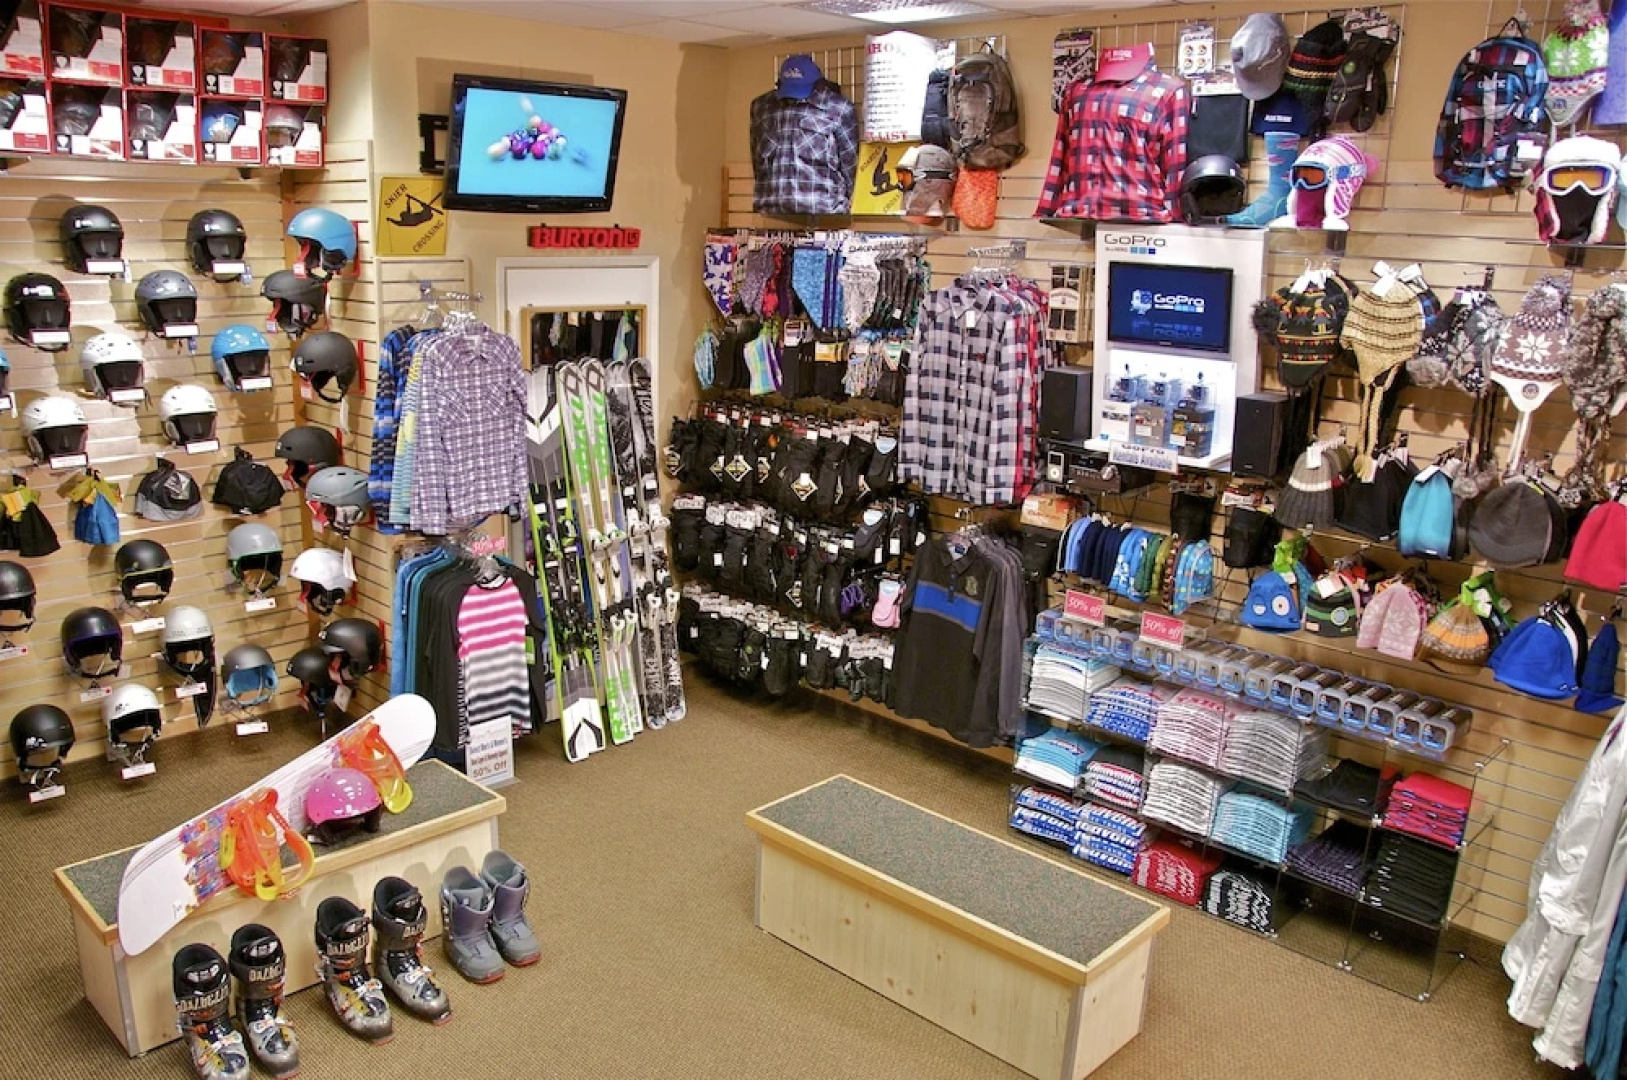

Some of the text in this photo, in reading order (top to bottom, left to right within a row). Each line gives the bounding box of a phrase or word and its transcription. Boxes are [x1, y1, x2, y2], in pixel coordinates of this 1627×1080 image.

[384, 183, 408, 209] SKIER
[412, 219, 445, 253] CROSSING
[531, 228, 625, 249] BURTON
[1104, 233, 1167, 247] GoPro
[1154, 293, 1205, 307] GoPro
[1068, 596, 1102, 617] 50% off
[1144, 618, 1181, 641] 50% off
[472, 760, 507, 778] 50% Off
